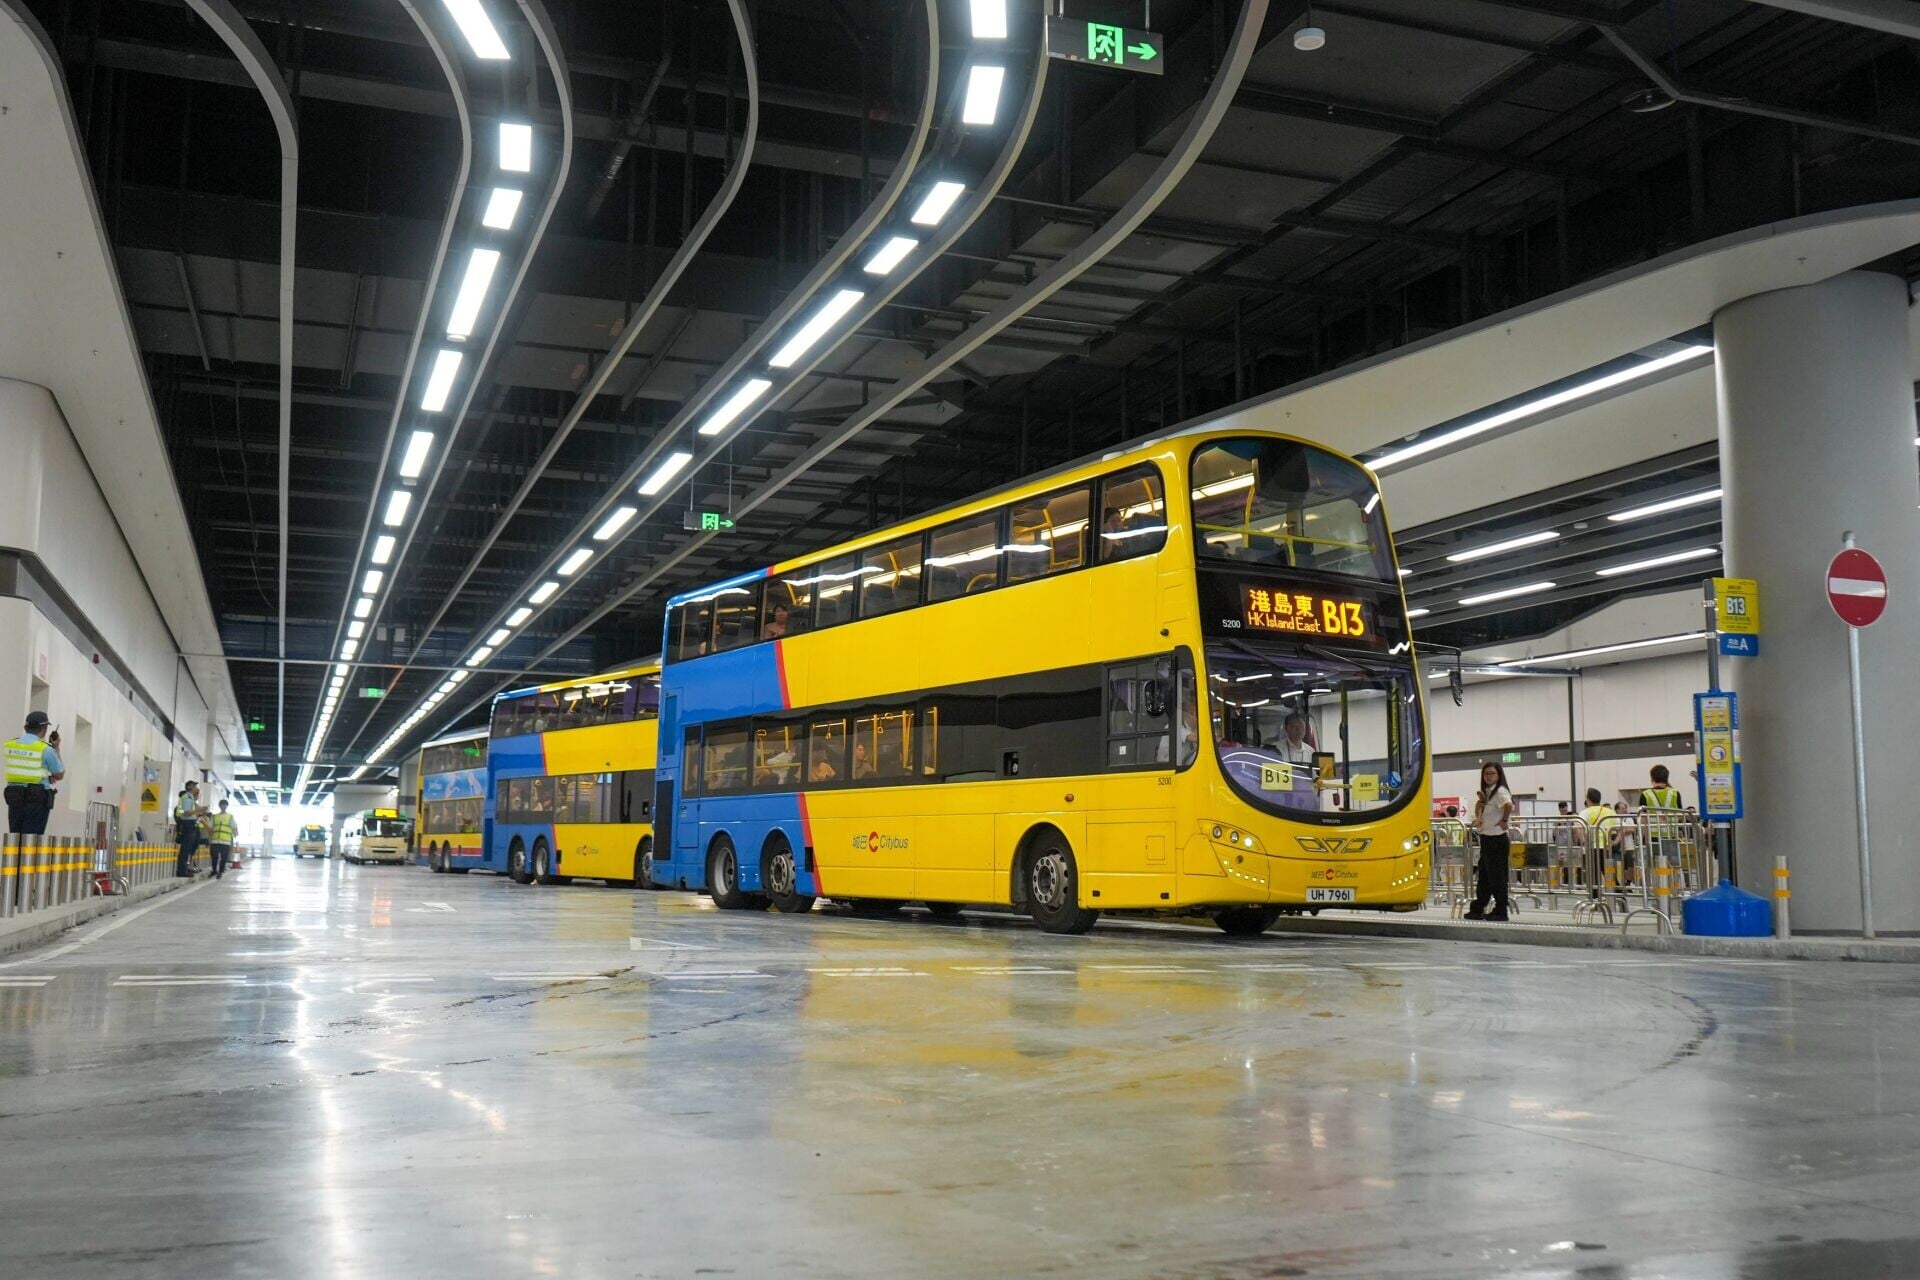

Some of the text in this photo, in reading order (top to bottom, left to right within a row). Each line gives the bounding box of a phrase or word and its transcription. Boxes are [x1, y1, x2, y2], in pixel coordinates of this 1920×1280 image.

[1249, 589, 1314, 617] 港島東
[1727, 597, 1745, 615] B13
[1222, 619, 1241, 629] 5200
[1248, 611, 1321, 633] HK Island East
[1322, 600, 1364, 636] B13
[1740, 637, 1749, 651] A
[1158, 777, 1172, 785] 5200
[1265, 769, 1290, 784] B13
[880, 835, 909, 850] Citybus
[1311, 890, 1350, 900] UH 7961
